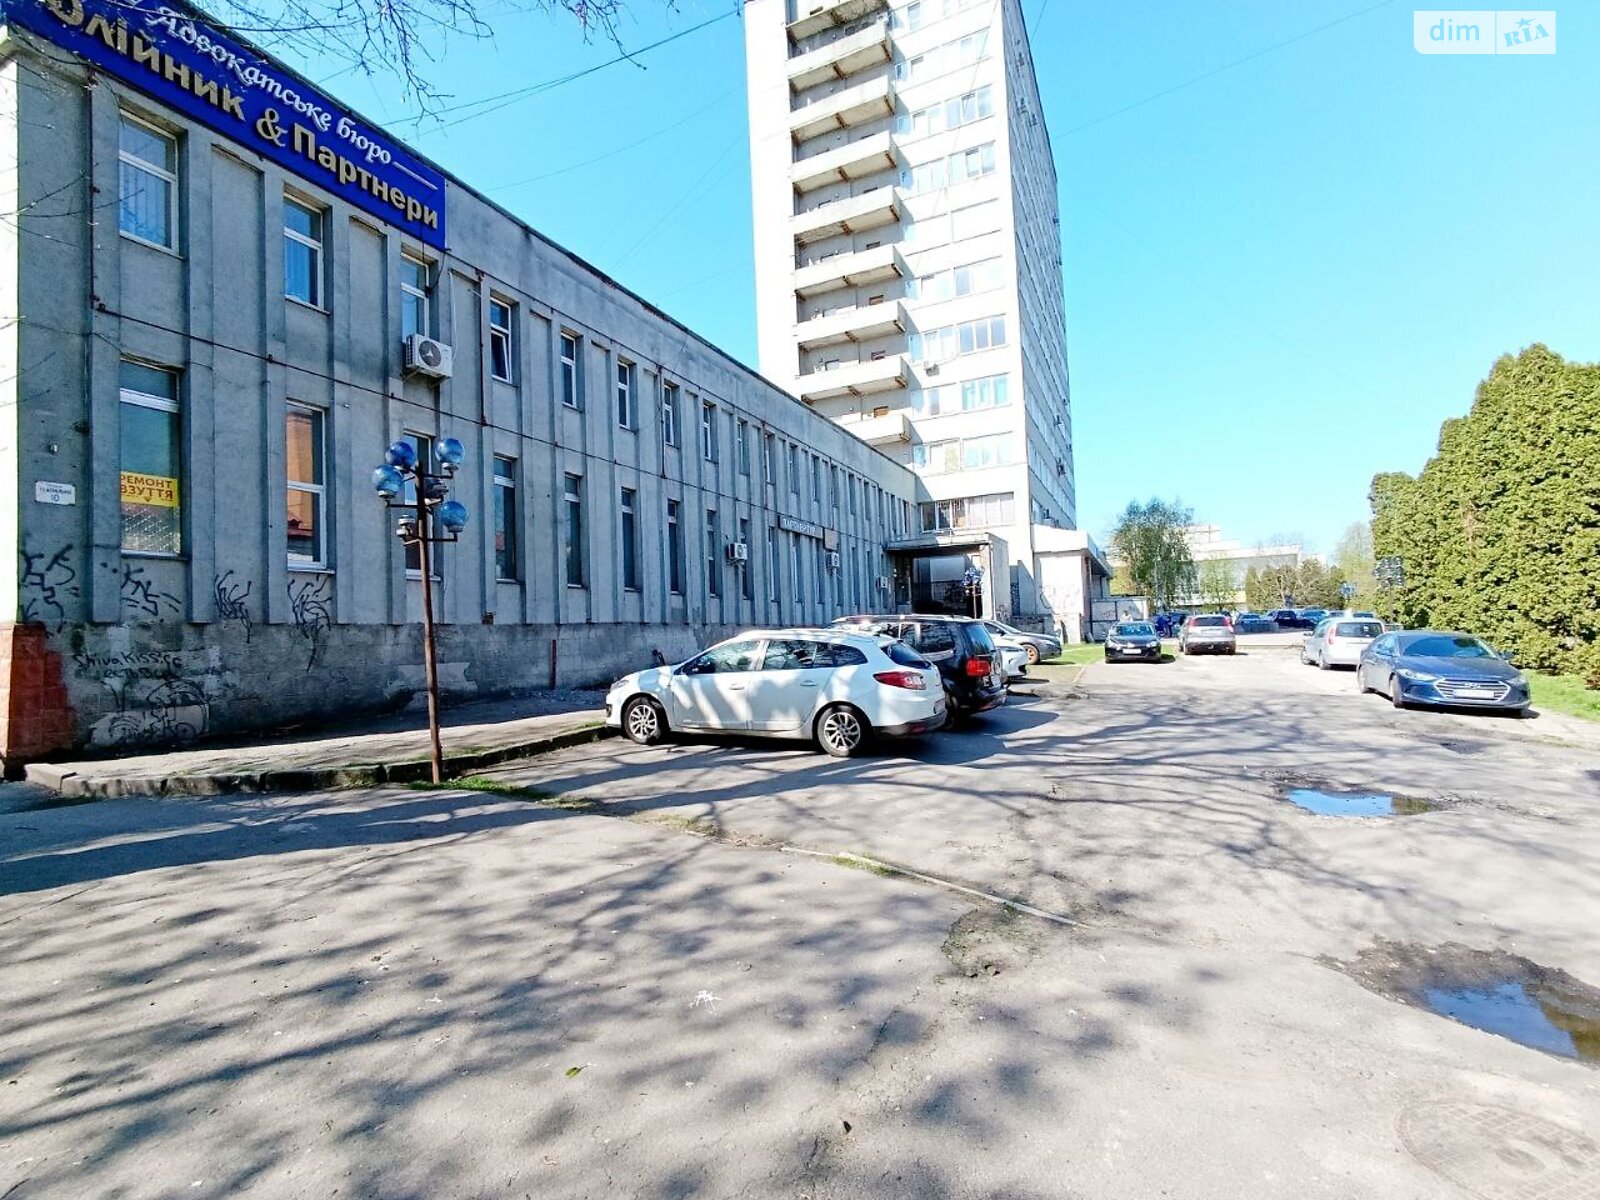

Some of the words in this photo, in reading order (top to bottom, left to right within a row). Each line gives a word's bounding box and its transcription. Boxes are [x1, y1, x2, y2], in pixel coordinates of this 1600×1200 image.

[145, 5, 332, 132] Адвокатське
[336, 117, 392, 164] бюро
[256, 107, 289, 147] &
[294, 122, 439, 230] Партнери
